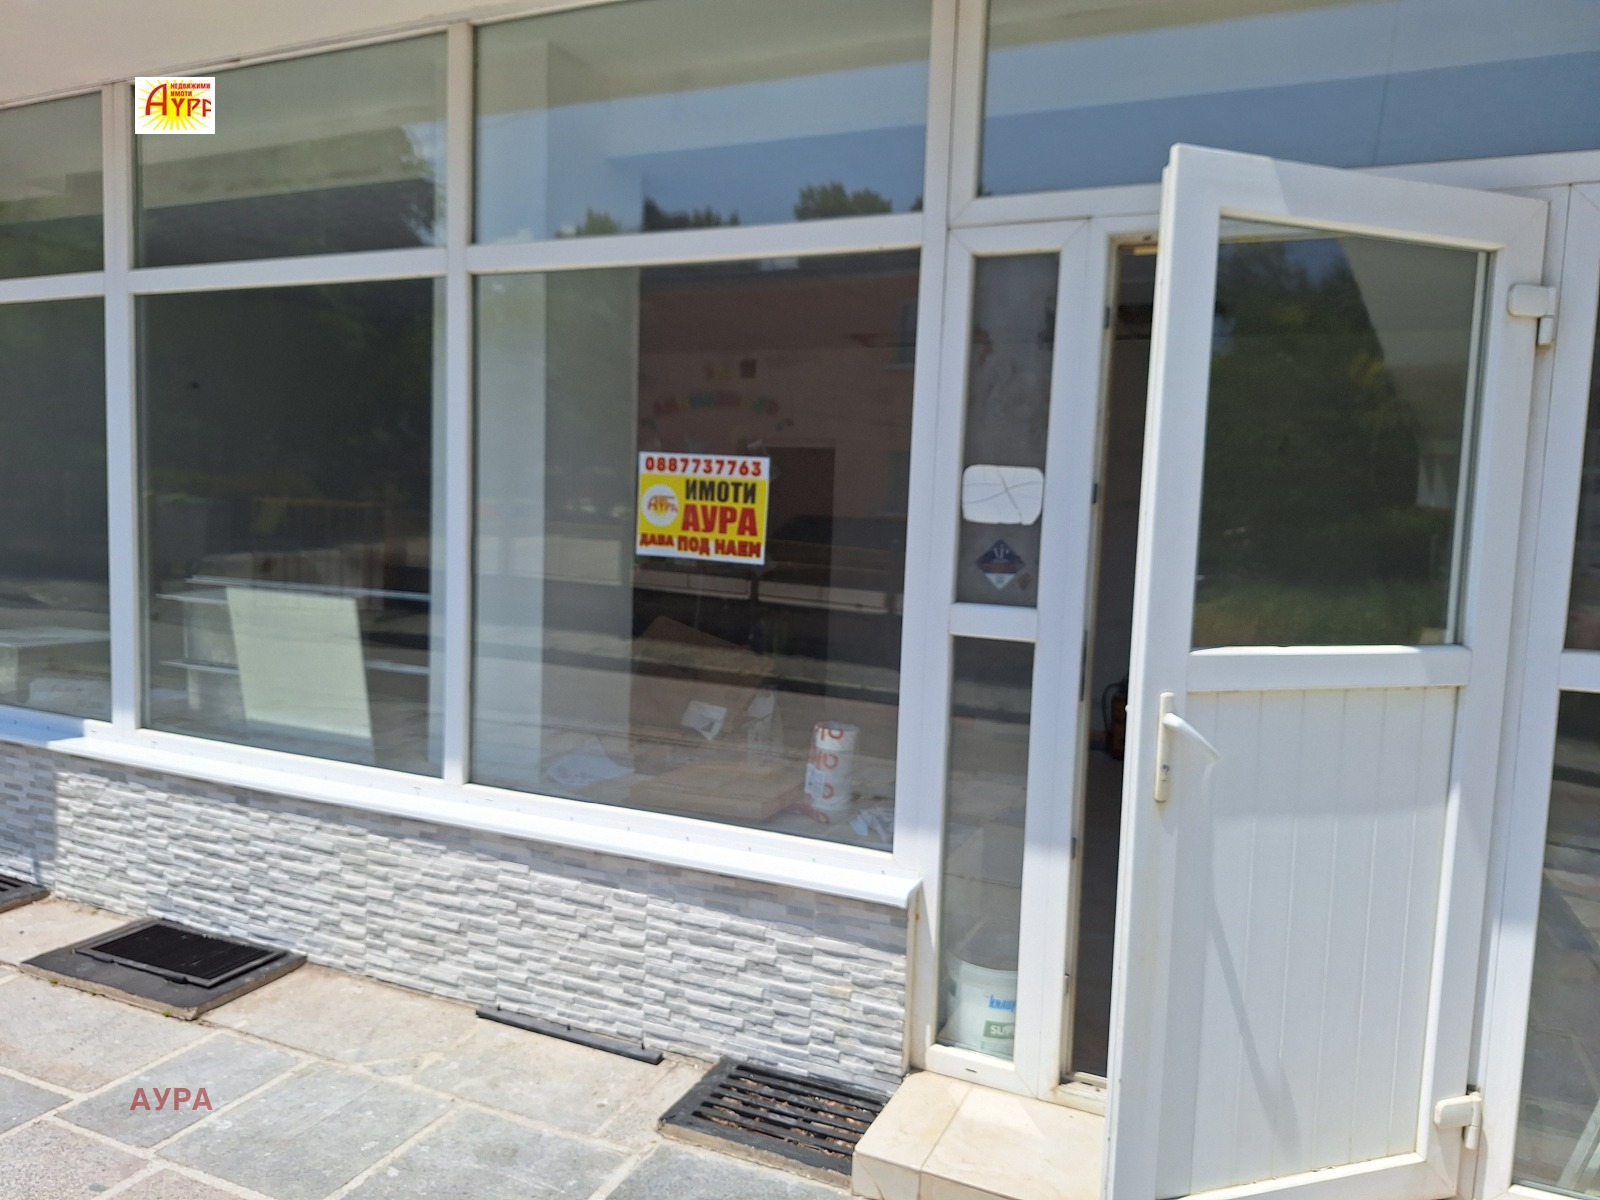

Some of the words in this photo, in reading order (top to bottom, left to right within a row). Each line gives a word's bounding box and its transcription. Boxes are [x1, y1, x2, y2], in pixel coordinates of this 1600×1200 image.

[645, 456, 762, 477] 0887737763
[685, 479, 757, 504] ИМОТИ
[681, 503, 758, 537] АУРА
[639, 533, 675, 547] ДАВА
[677, 536, 711, 556] ПОД
[715, 539, 762, 558] НАЕМ
